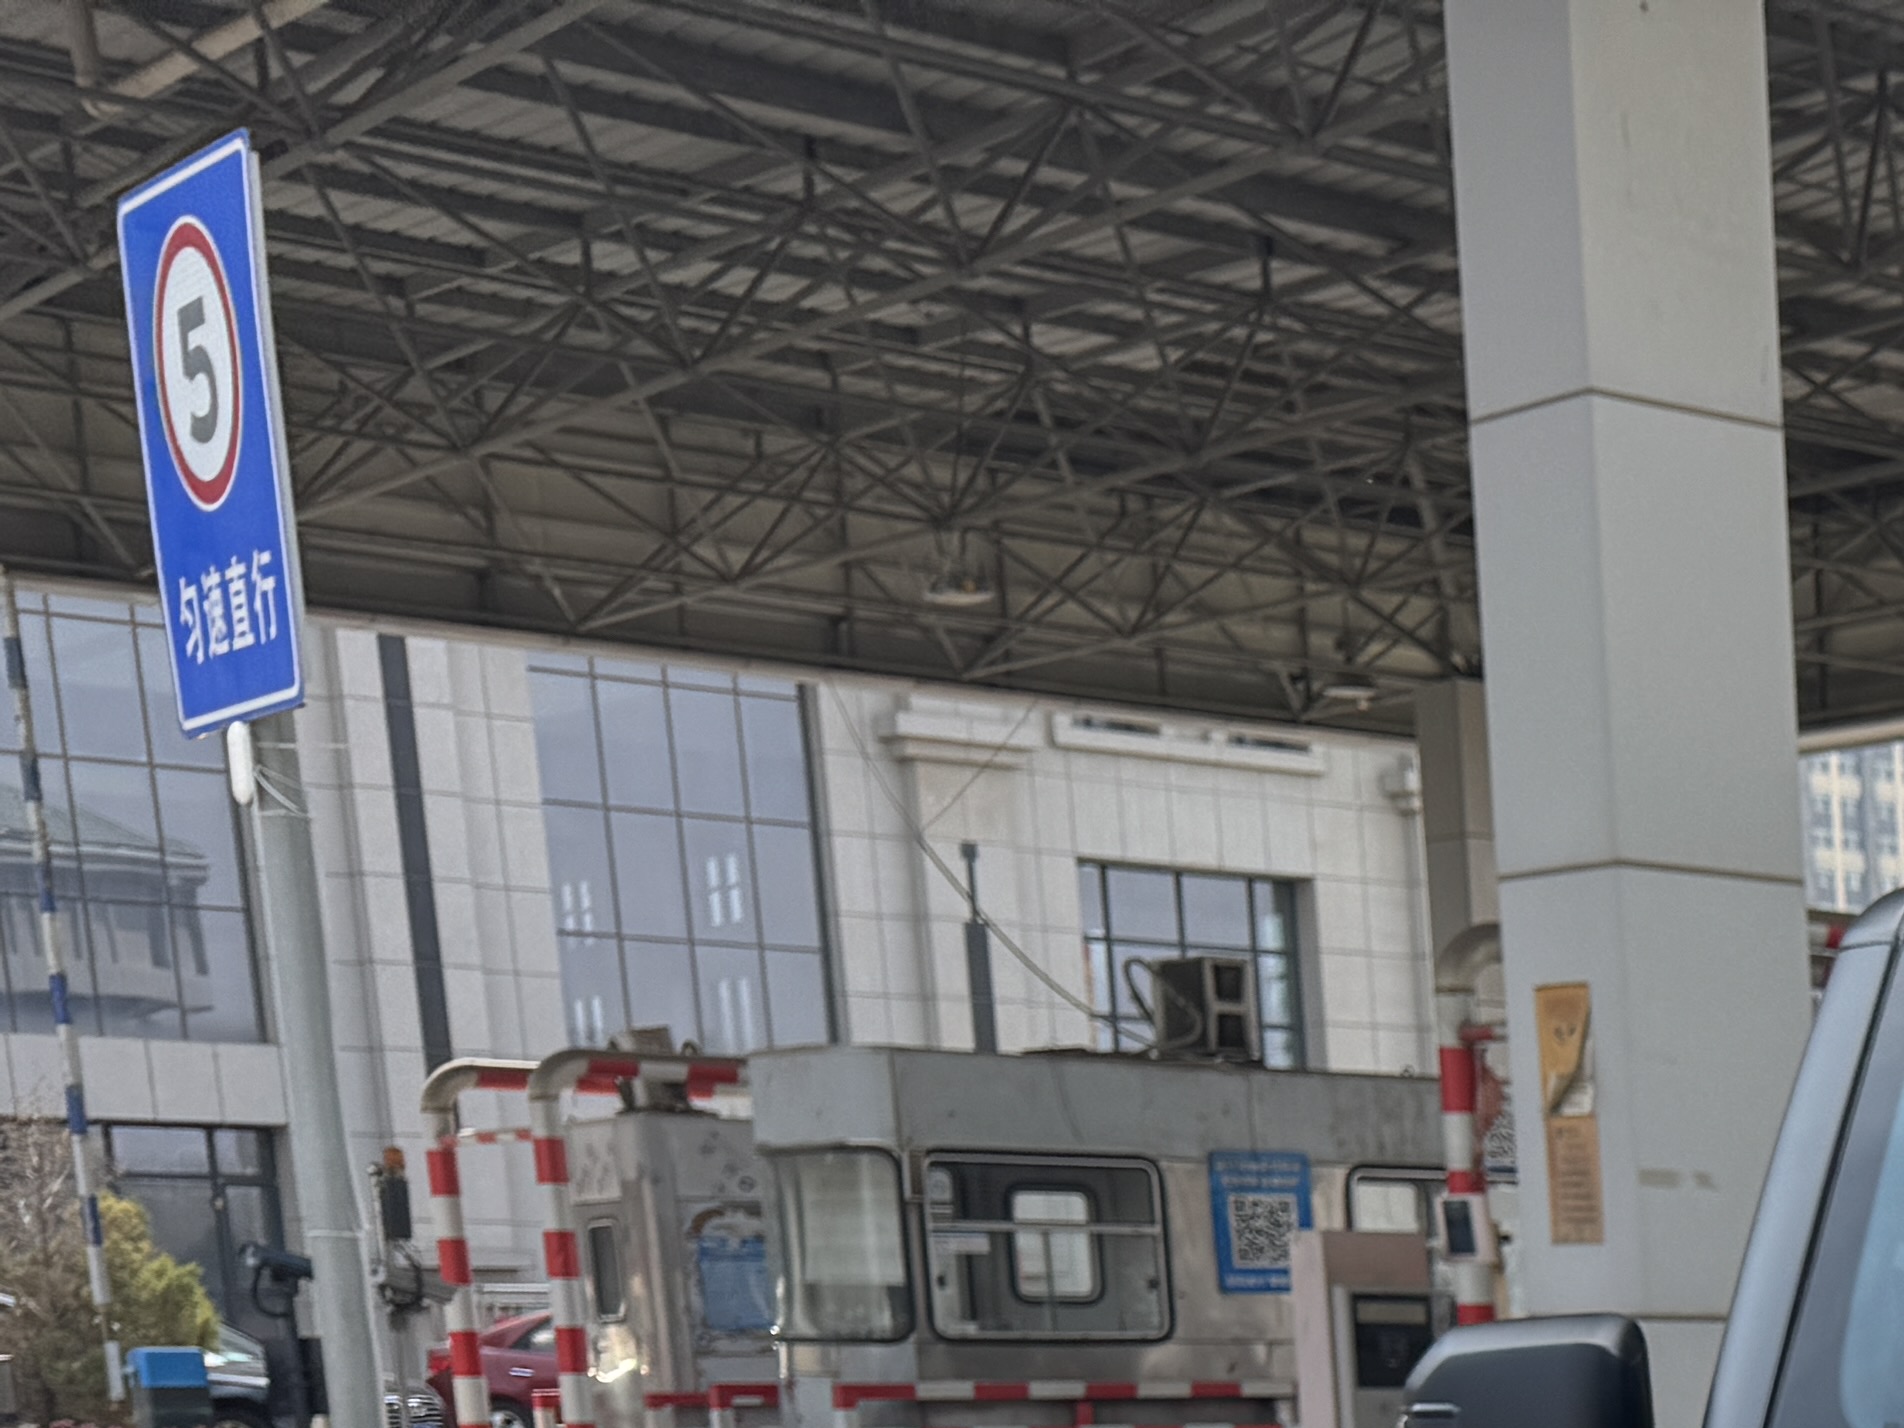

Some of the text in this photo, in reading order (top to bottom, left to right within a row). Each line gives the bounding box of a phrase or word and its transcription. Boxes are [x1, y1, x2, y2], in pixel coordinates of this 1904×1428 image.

[177, 296, 218, 446] 5
[178, 548, 278, 666] 匀速直行
